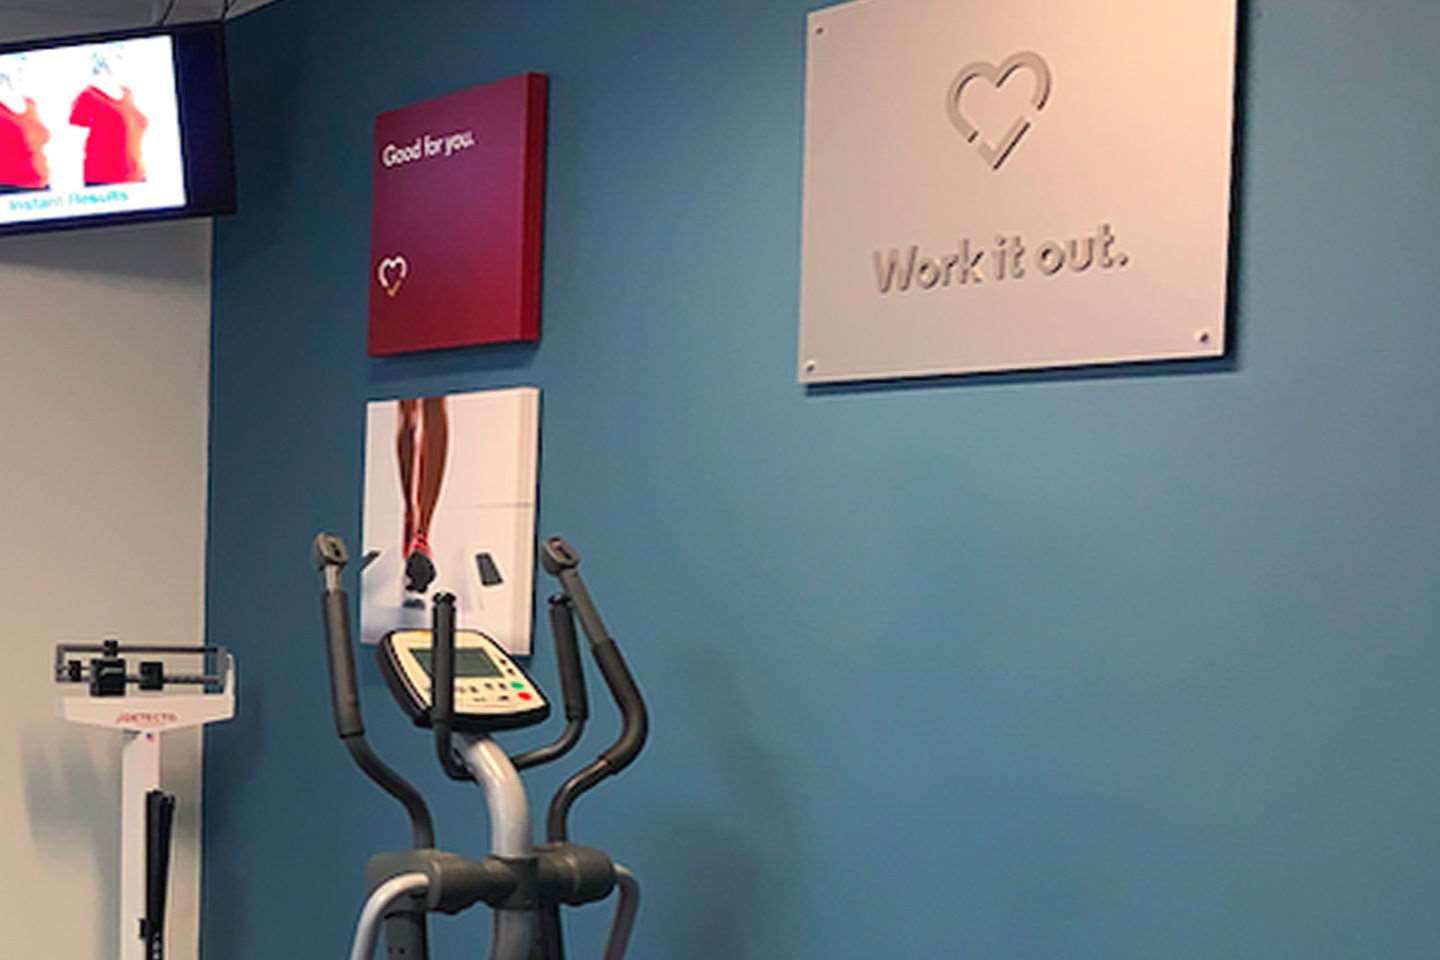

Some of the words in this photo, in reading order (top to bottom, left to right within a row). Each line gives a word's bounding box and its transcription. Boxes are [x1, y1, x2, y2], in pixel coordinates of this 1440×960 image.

[382, 136, 421, 167] Good
[424, 134, 443, 156] for
[445, 131, 475, 156] you.
[9, 196, 63, 211] Instant
[68, 189, 129, 204] Results
[873, 238, 984, 294] Work
[994, 234, 1026, 281] it
[1036, 223, 1129, 276] out.
